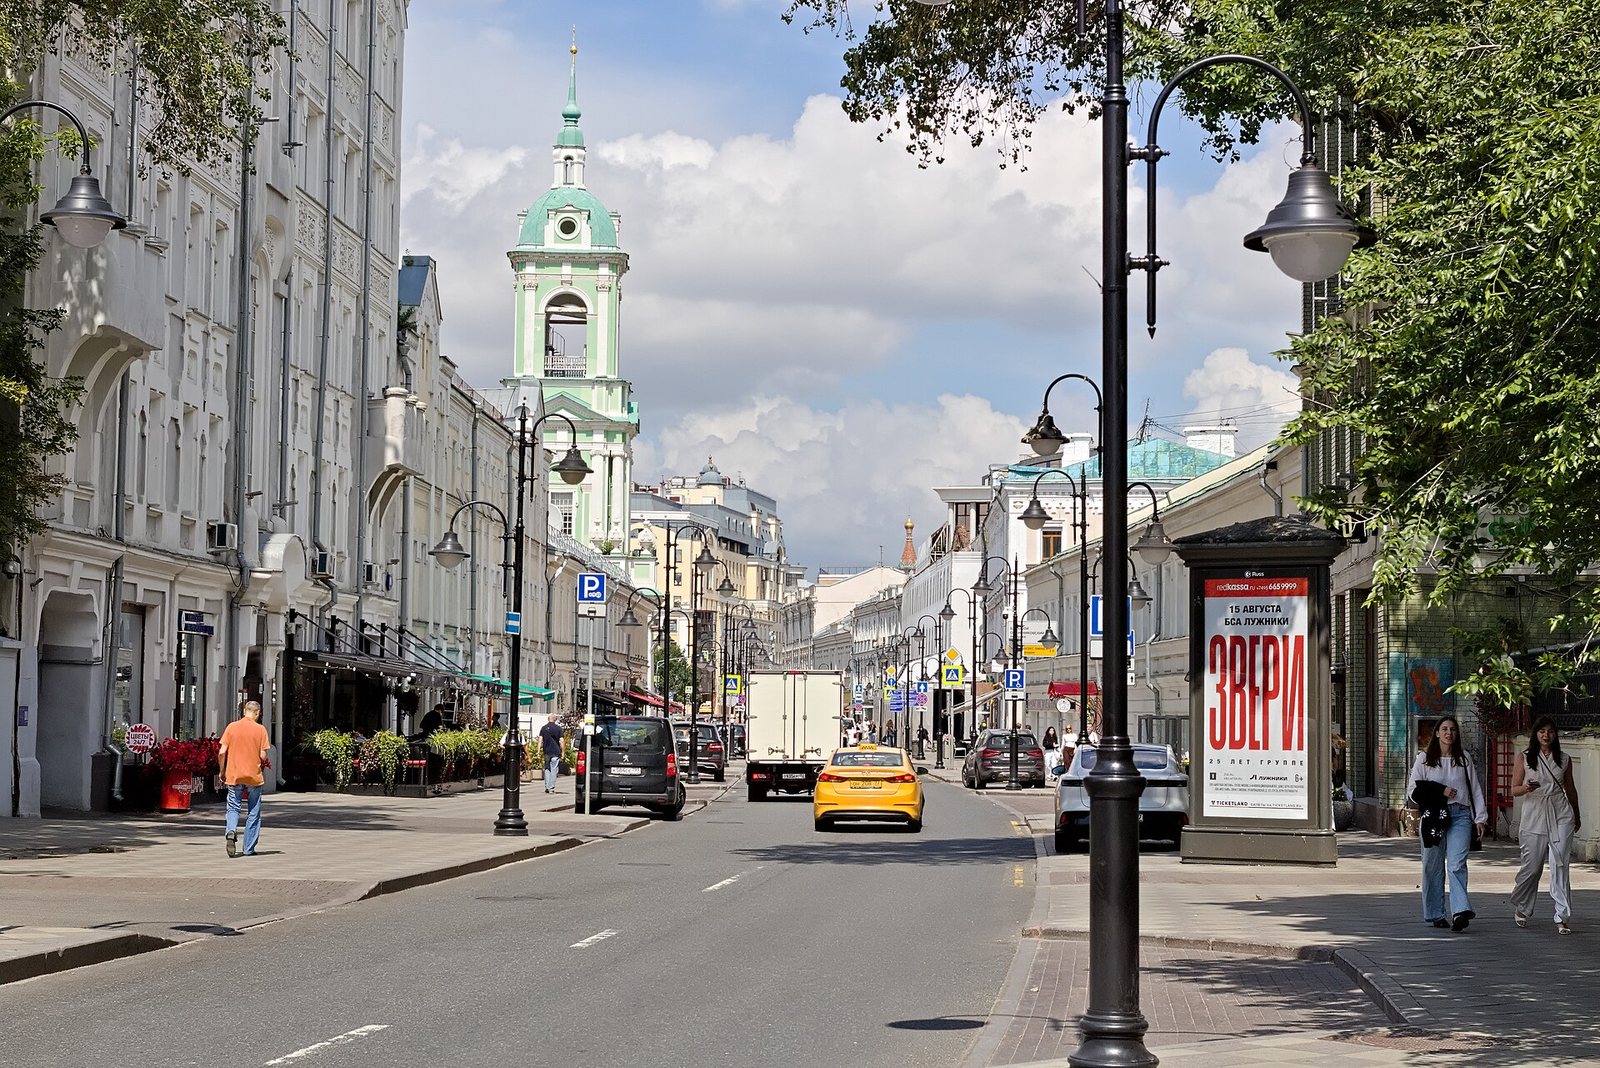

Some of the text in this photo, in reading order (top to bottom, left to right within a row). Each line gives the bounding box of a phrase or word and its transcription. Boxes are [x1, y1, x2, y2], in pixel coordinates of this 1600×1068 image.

[1216, 583, 1256, 591] redkassa.ru
[1229, 604, 1281, 613] 15 АВГУСТА
[1224, 617, 1289, 626] БСА ЛУЖНИКИ
[1209, 634, 1304, 751] ЗВЕРИ
[1294, 774, 1303, 782] 6+
